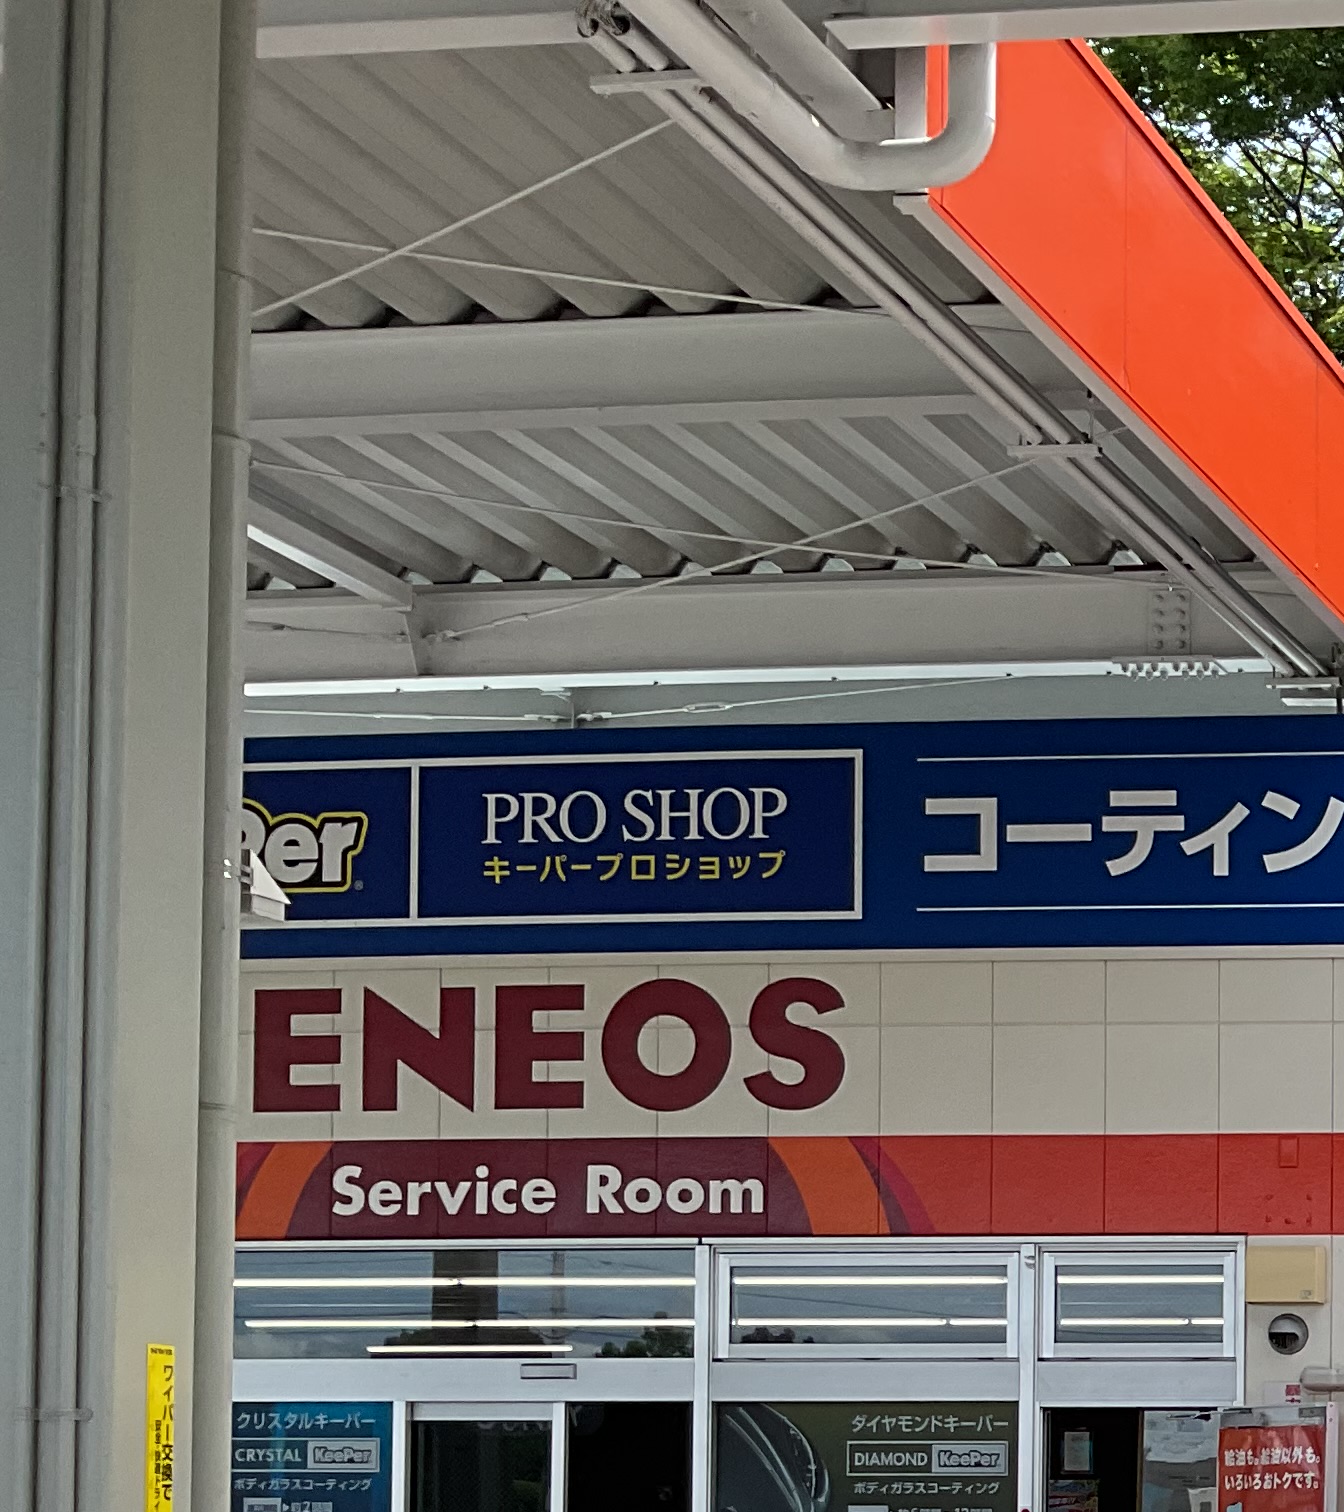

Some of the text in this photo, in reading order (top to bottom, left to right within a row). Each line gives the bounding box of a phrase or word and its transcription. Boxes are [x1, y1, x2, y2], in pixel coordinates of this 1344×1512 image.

[481, 787, 788, 844] PRO SHOP
[483, 851, 786, 883] キーパープロショップ
[253, 977, 846, 1113] ENEOS
[331, 1164, 764, 1216] Service Room
[237, 1413, 376, 1430] クリスタルキーパー
[852, 1415, 1008, 1432] ダイヤモンドキーパー
[235, 1446, 372, 1463] CRYSTAL KeePer
[854, 1450, 1000, 1467] DIAMOND KeePer
[854, 1481, 1000, 1494] ボディガラスコーティング
